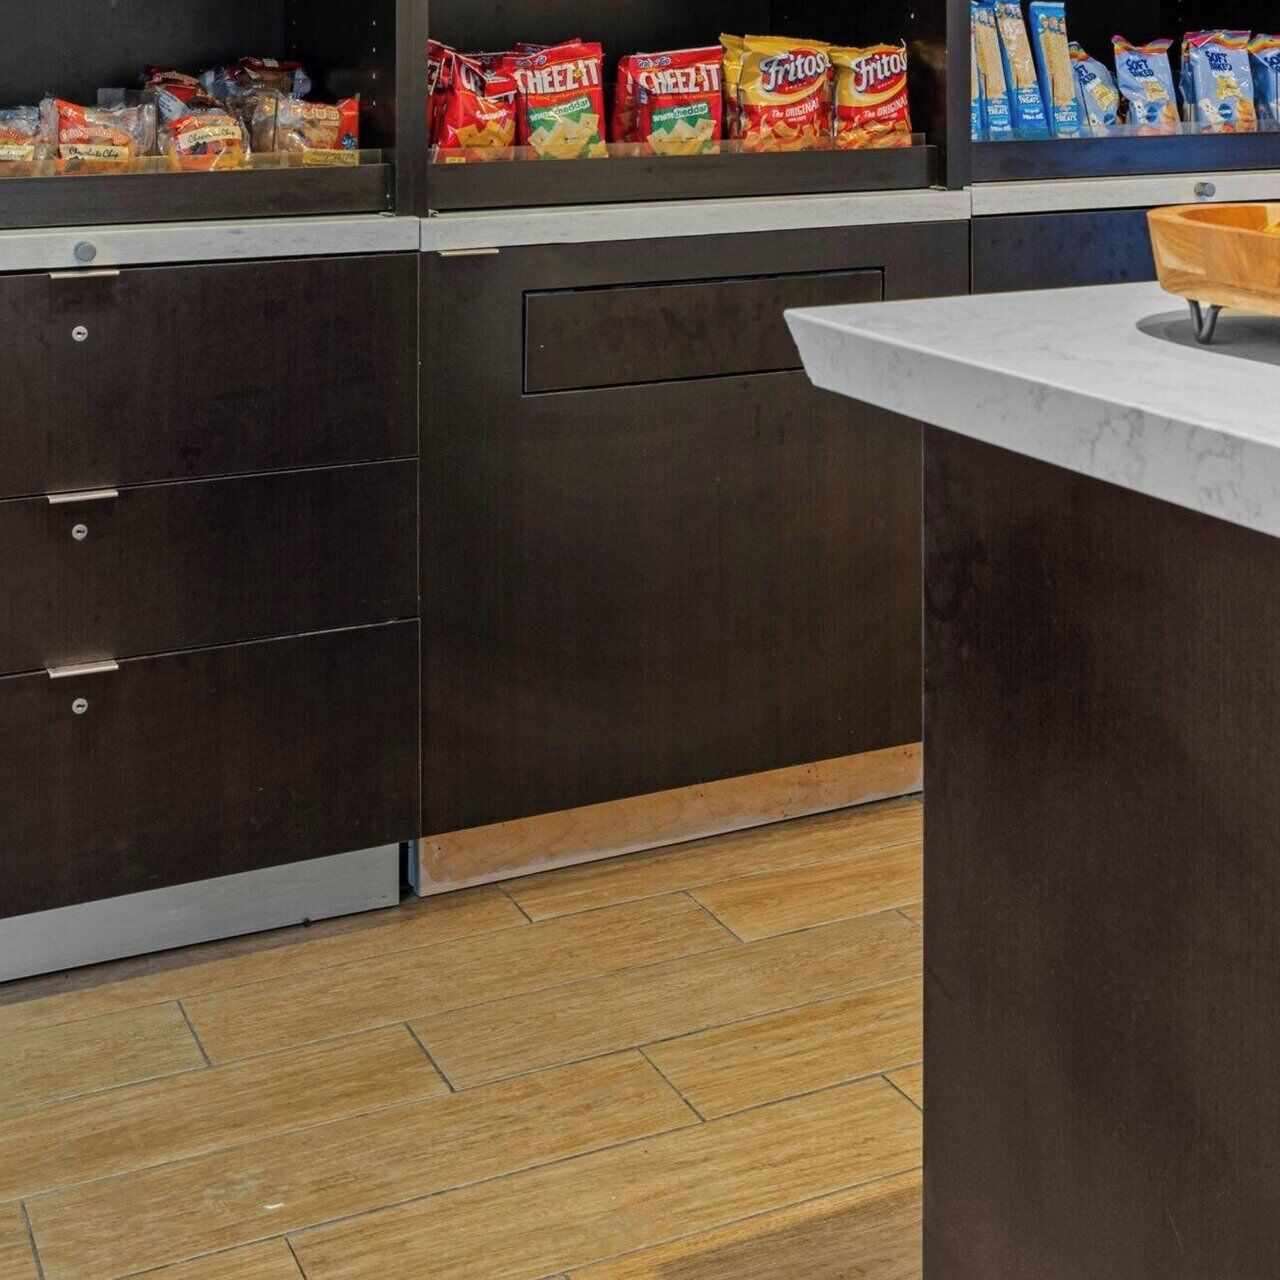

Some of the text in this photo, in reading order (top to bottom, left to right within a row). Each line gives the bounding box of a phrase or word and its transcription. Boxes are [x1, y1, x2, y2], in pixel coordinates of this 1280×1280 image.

[1126, 58, 1148, 71] SOFT
[1205, 50, 1228, 64] SOFT
[760, 51, 831, 93] Fritos
[553, 96, 591, 117] cheddar
[772, 98, 820, 118] The ORIGINAL
[863, 109, 876, 118] The
